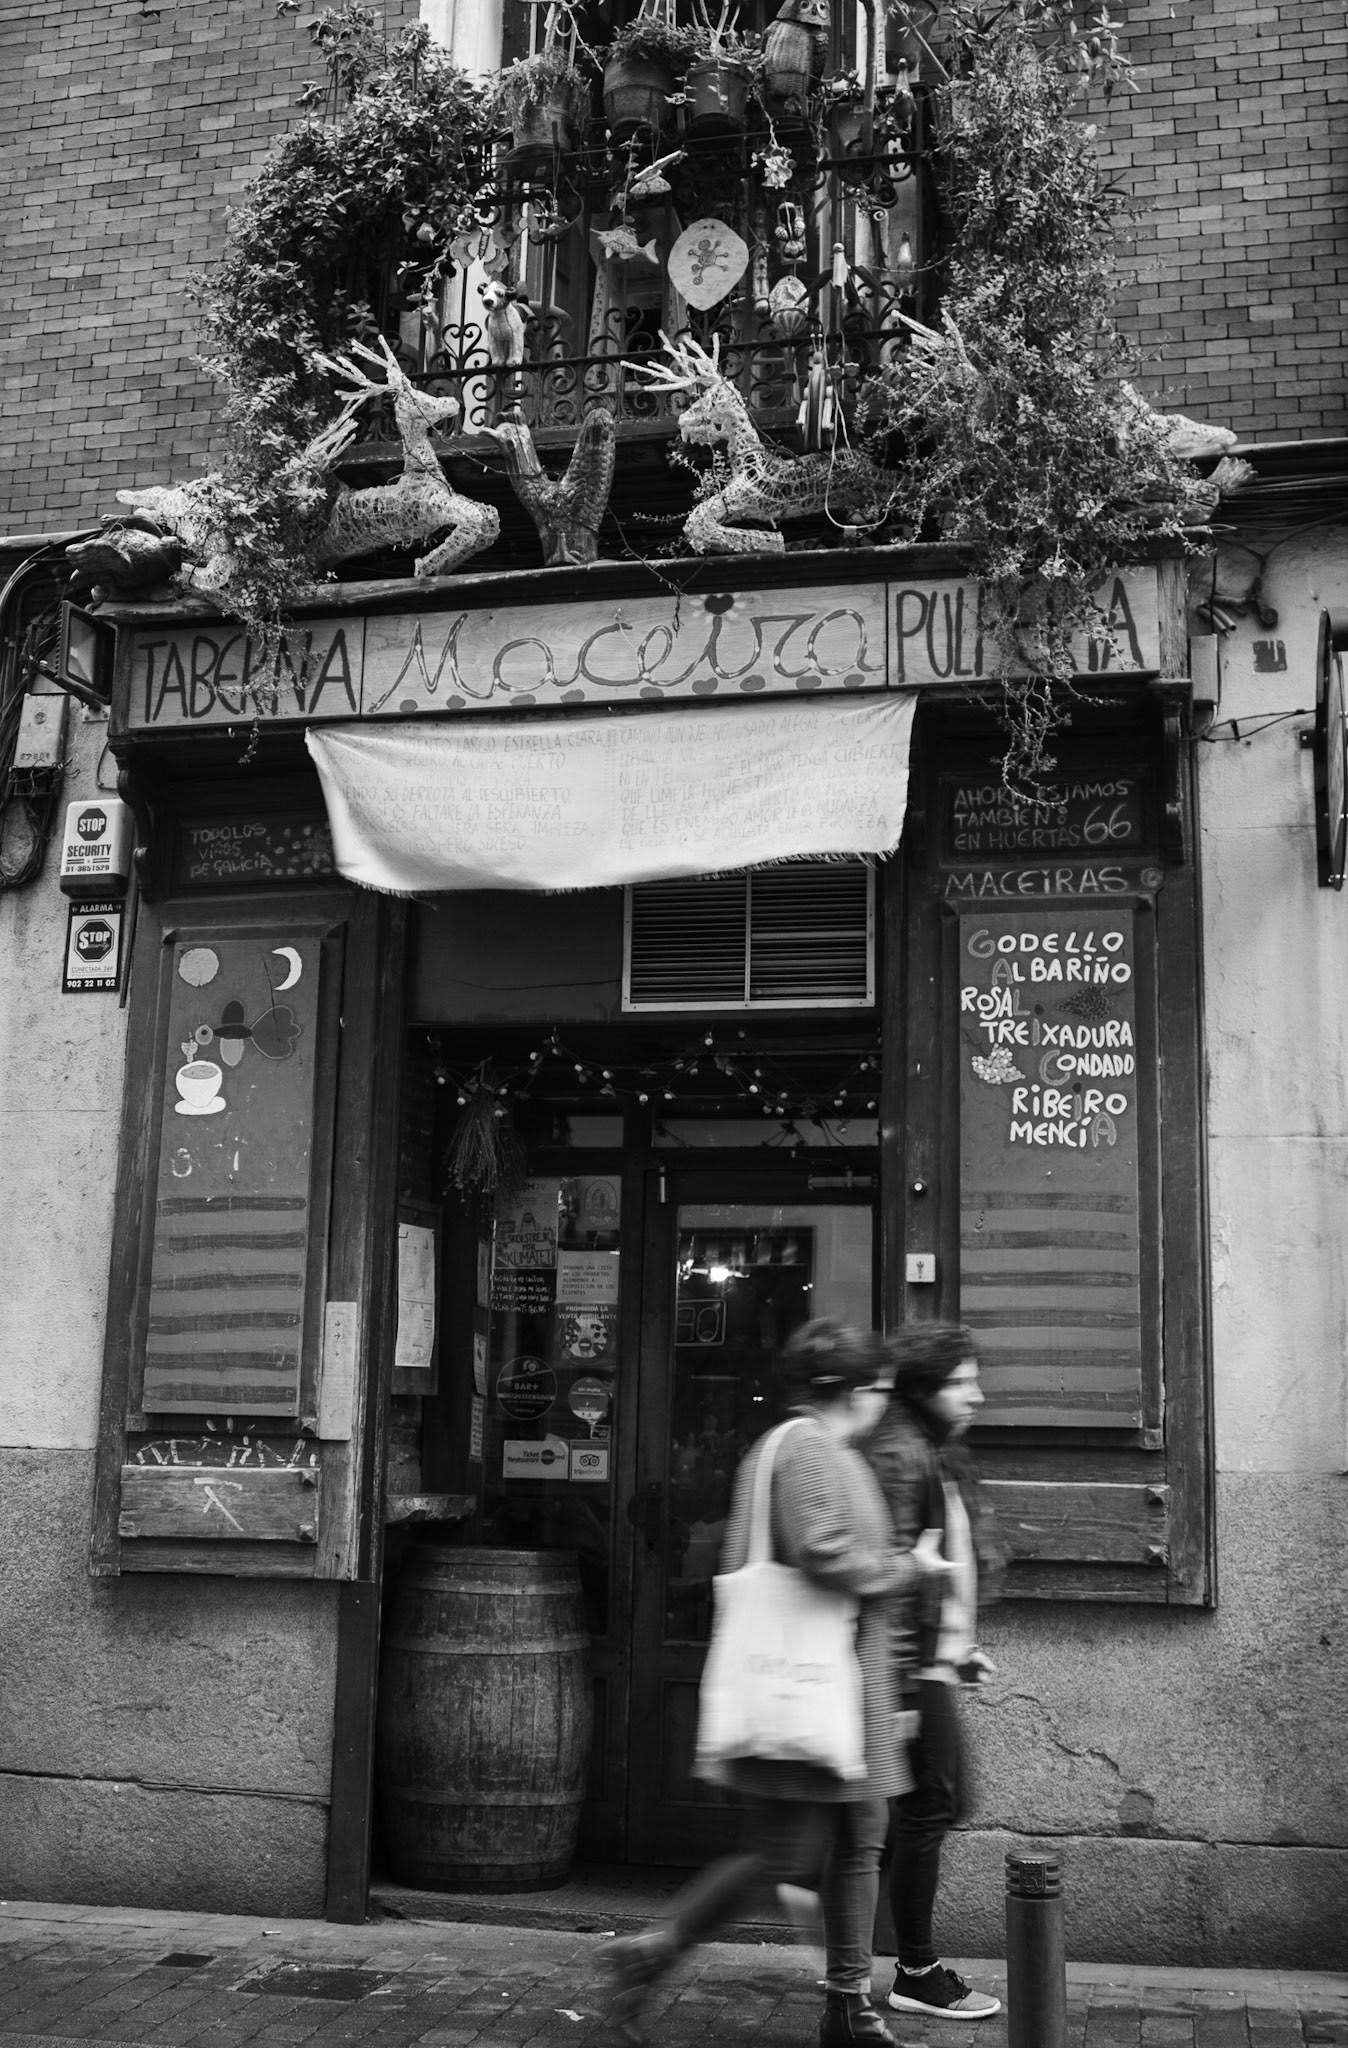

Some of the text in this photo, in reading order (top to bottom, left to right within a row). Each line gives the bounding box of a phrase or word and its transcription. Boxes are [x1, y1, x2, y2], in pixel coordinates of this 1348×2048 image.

[504, 733, 562, 752] ESTRELLA
[479, 786, 572, 804] DESCUBIERTO
[487, 802, 561, 821] ESPERANZA
[79, 817, 106, 832] STOP
[954, 802, 1132, 850] EN HUERTAS 66
[67, 844, 112, 857] SECURITY
[944, 866, 1129, 899] MACEIRAS
[79, 903, 114, 914] ALARMA
[78, 930, 111, 950] STOP
[967, 929, 1124, 959] GODELLO
[991, 954, 1132, 986] ALBARIÑO
[66, 978, 116, 989] 902 22 11 02
[960, 986, 1031, 1020] ROSAL
[979, 1018, 1134, 1049] TREIXADURA
[1039, 1050, 1135, 1086] CONDADO
[1012, 1084, 1128, 1121] RIBEIRO
